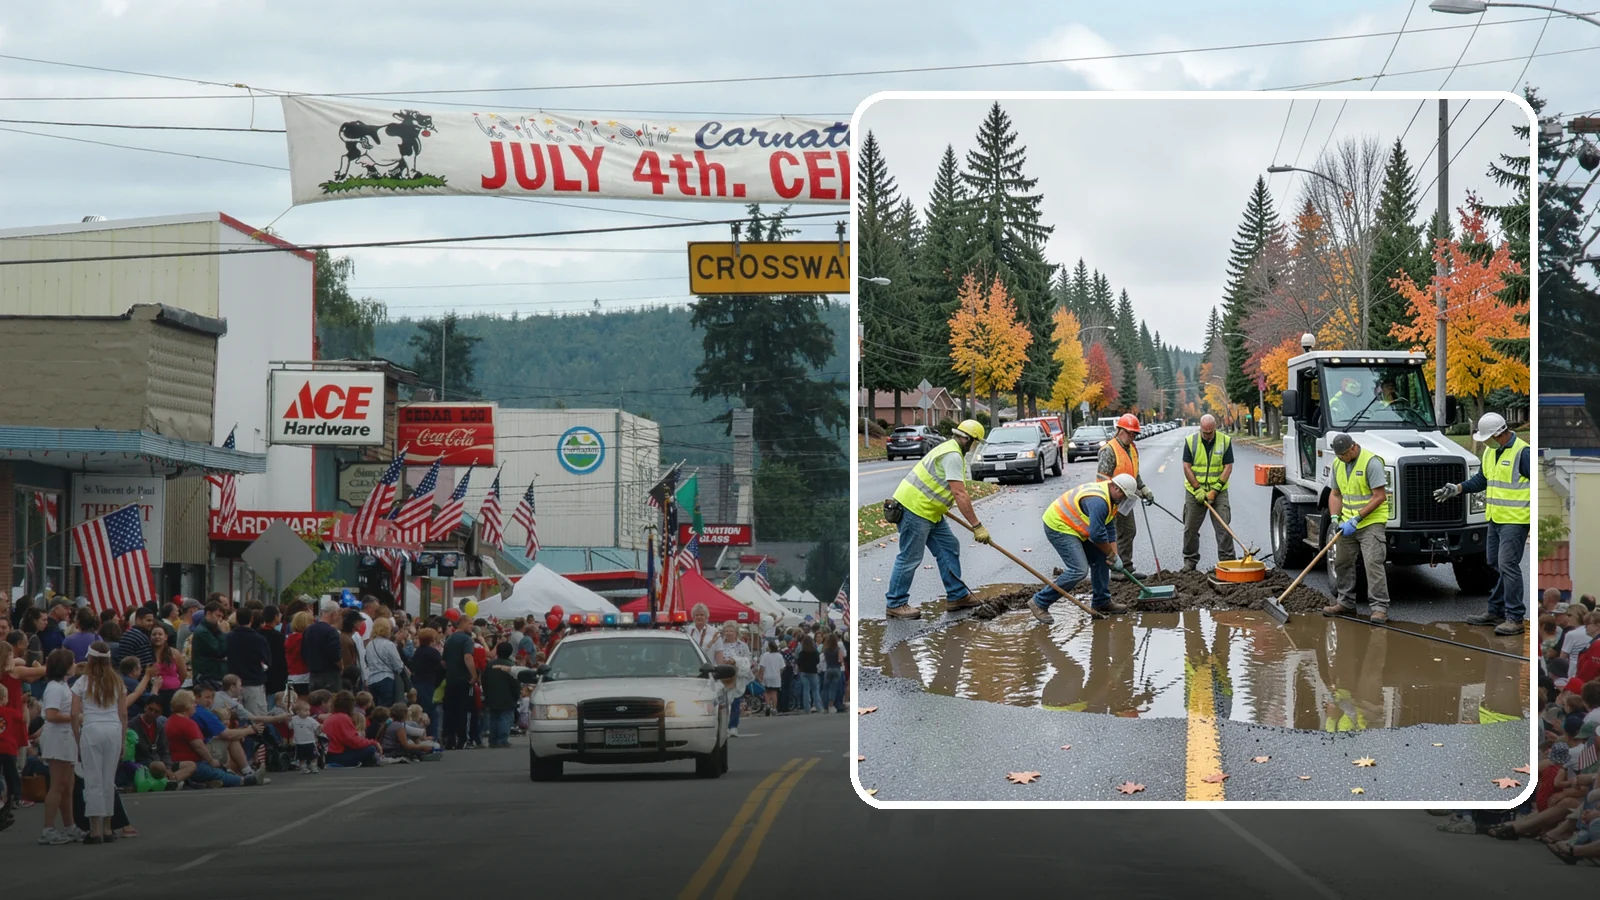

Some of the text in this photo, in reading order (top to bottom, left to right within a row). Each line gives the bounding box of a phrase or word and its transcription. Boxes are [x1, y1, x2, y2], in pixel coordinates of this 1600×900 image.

[695, 121, 850, 150] Carnat
[481, 140, 605, 192] JULY
[632, 150, 746, 197] 4th.
[697, 254, 850, 280] CROSSWA
[282, 380, 374, 420] ACE
[406, 409, 485, 421] CEDAR LOG
[283, 421, 371, 436] Hardware
[416, 428, 477, 446] Coca-Cola
[353, 467, 386, 481] Simpl
[95, 485, 124, 495] Vincent
[126, 485, 136, 495] de
[138, 485, 155, 495] Paul
[688, 526, 742, 535] CRNATION
[699, 535, 731, 543] GLASS
